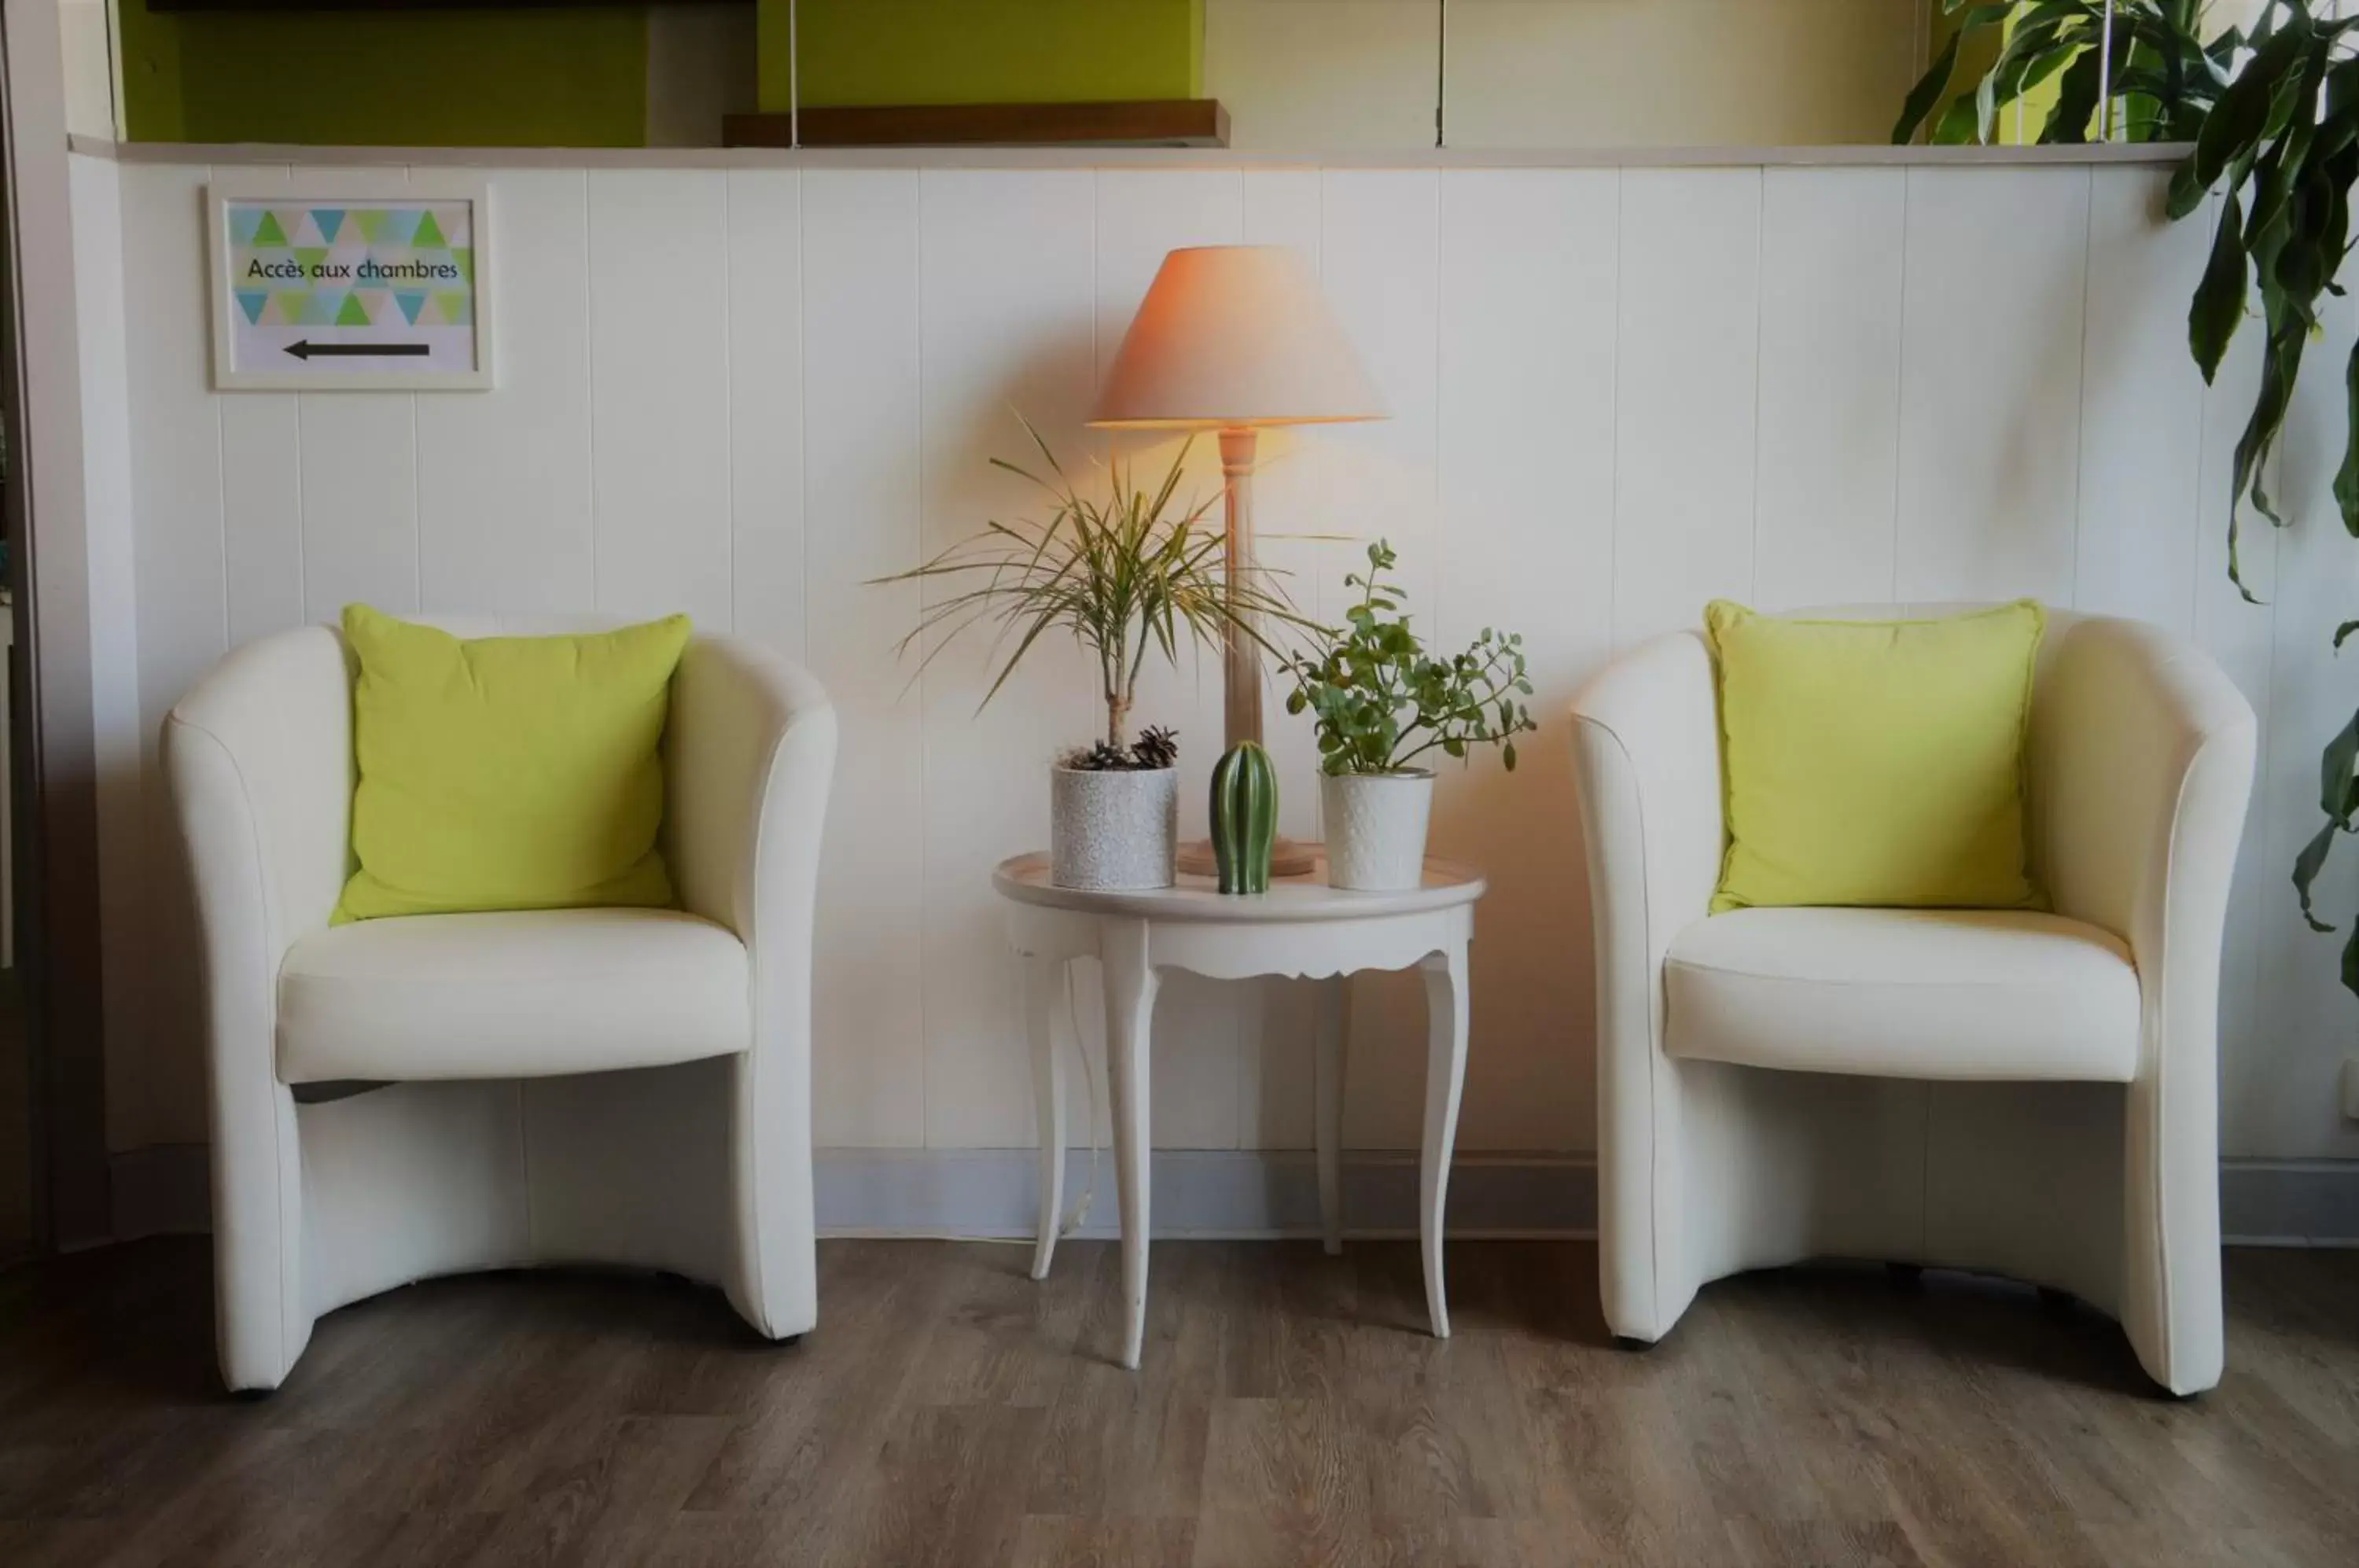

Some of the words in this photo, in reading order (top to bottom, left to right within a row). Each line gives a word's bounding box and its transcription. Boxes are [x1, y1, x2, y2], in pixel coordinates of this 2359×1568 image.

[248, 259, 305, 278] Accès
[311, 266, 351, 278] aux
[356, 259, 458, 279] chambres
